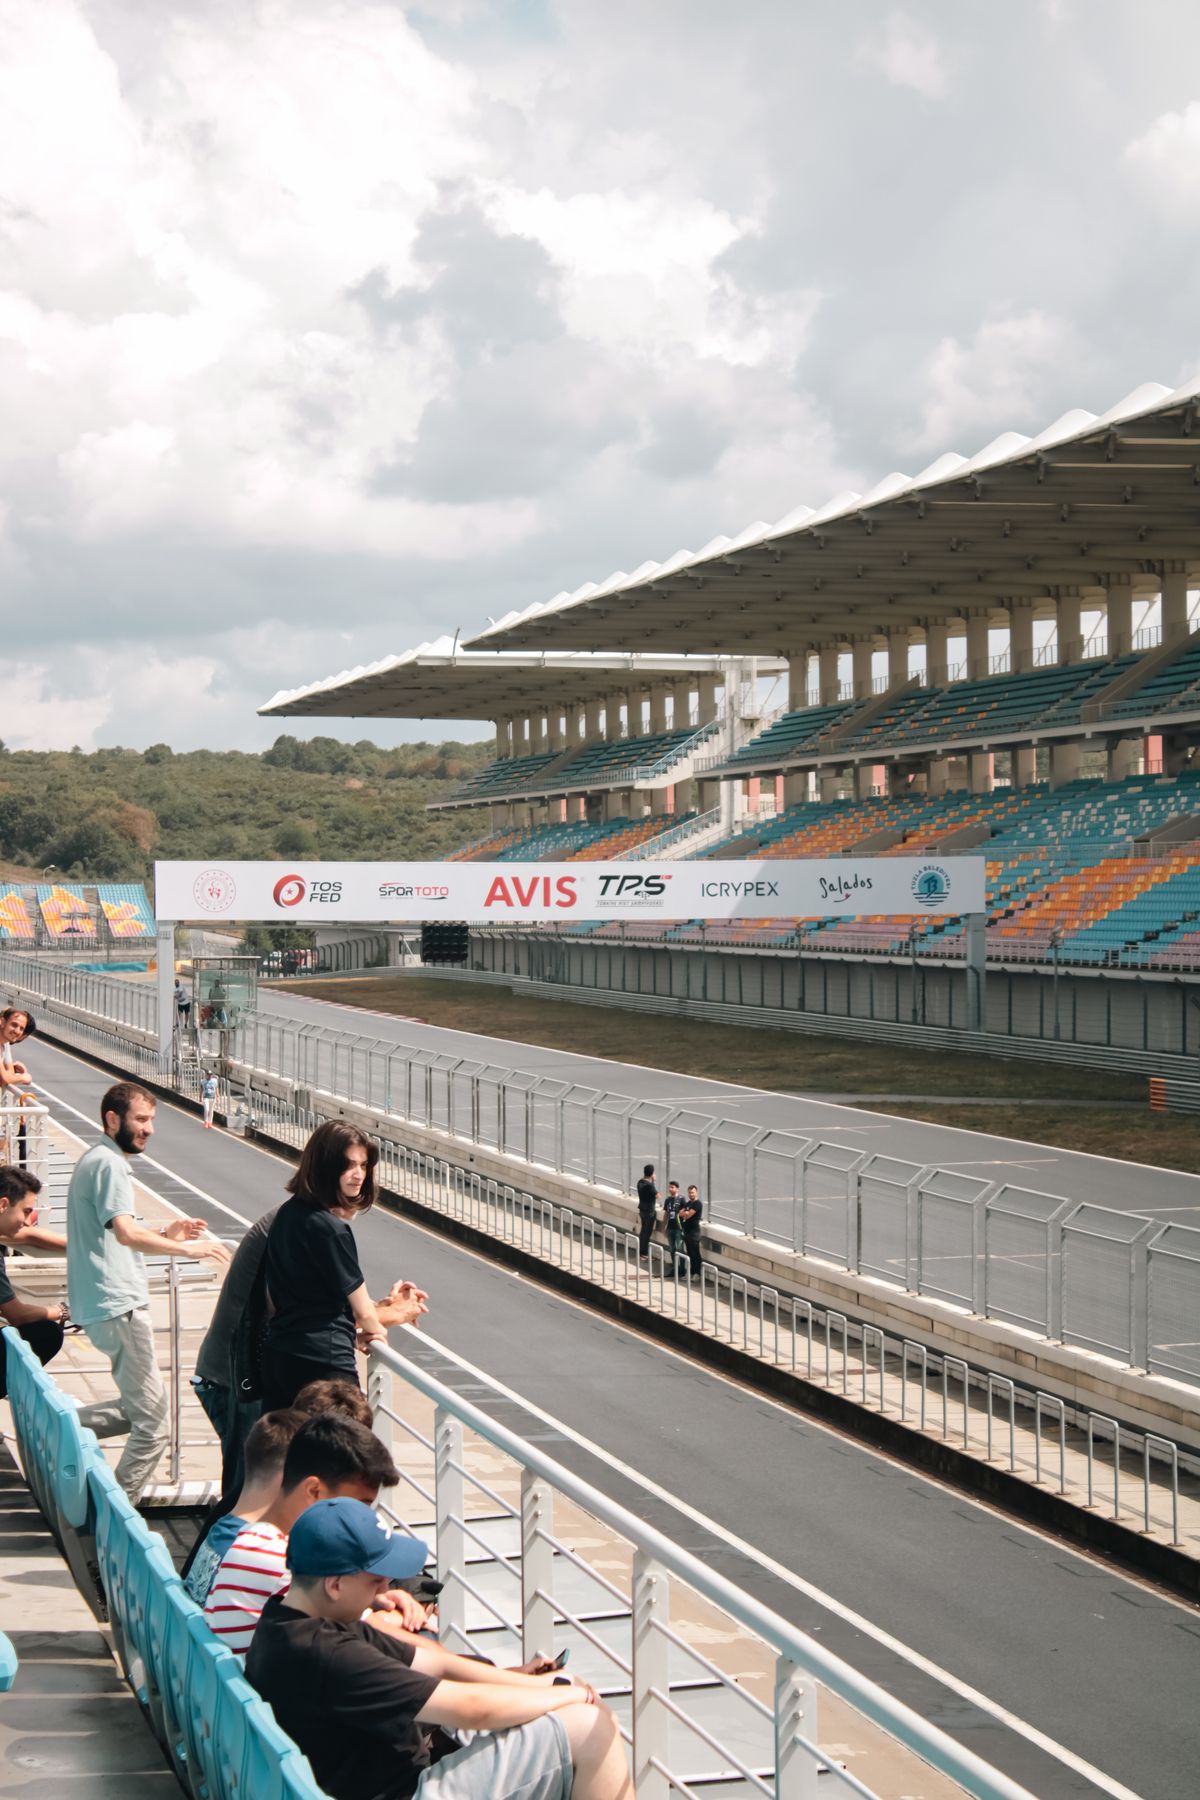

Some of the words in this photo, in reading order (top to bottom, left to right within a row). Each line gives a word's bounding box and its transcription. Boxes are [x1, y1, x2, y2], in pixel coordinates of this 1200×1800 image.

[310, 881, 343, 892] TOS
[598, 875, 666, 896] TPS
[701, 881, 779, 897] ICRYPEX
[819, 873, 873, 899] Salados
[911, 869, 923, 890] TUZLA
[309, 892, 342, 903] FED
[484, 876, 577, 908] AVIS
